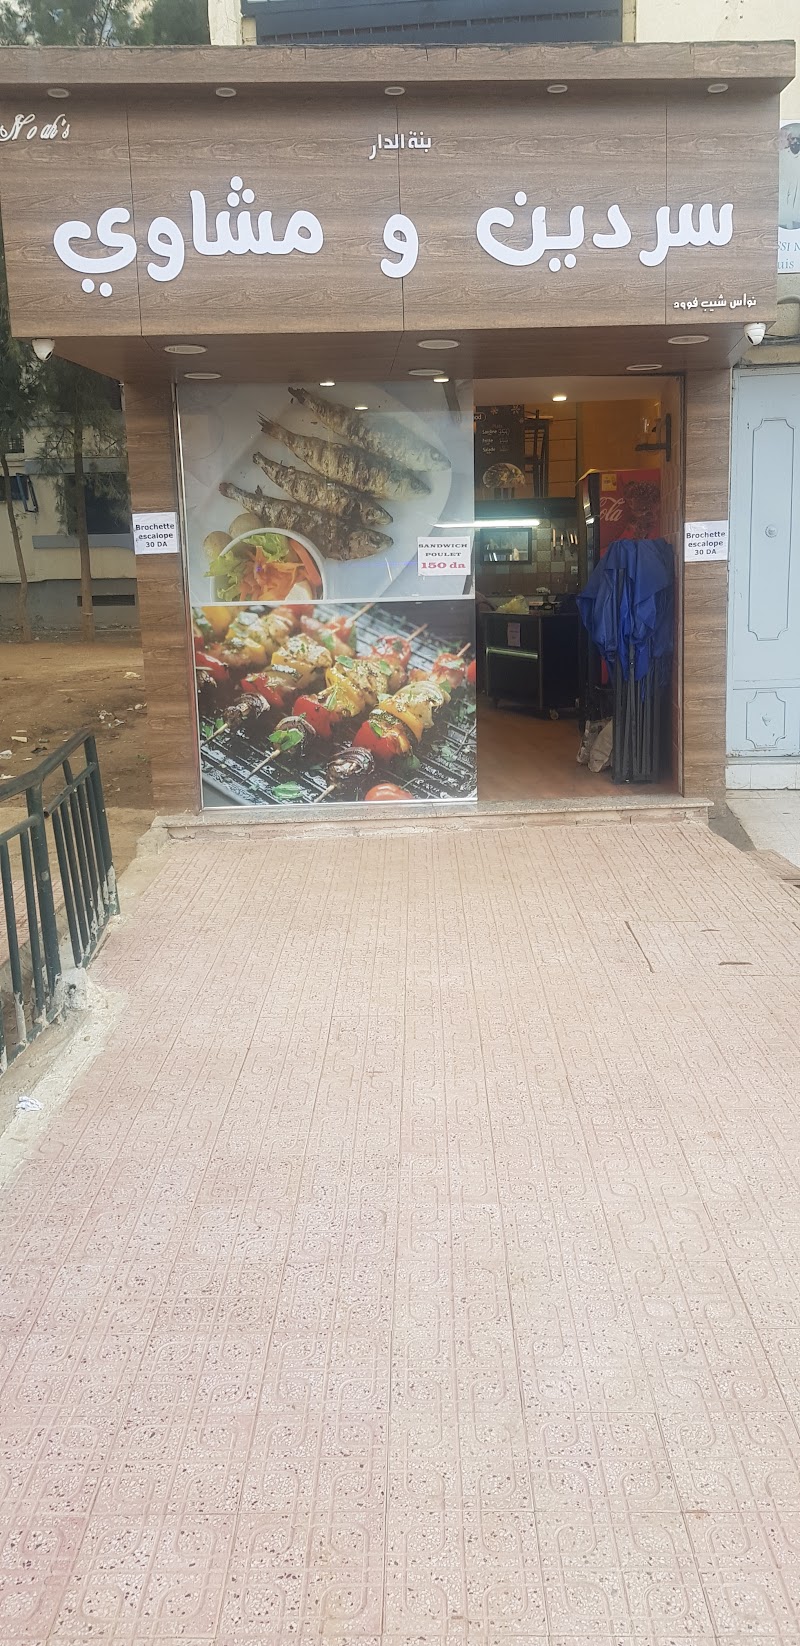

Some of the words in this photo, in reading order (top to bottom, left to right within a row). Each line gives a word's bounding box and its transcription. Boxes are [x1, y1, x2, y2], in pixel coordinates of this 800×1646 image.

[368, 133, 405, 160] الدار
[408, 130, 432, 153] بنة
[53, 175, 324, 297] مشاوي
[476, 191, 734, 272] سردين
[380, 213, 419, 279] و
[135, 523, 175, 531] Brochette
[138, 532, 174, 540] escalope
[686, 531, 726, 539] Brochette
[688, 540, 724, 548] escalope
[421, 561, 447, 569] 150
[449, 561, 466, 569] da
